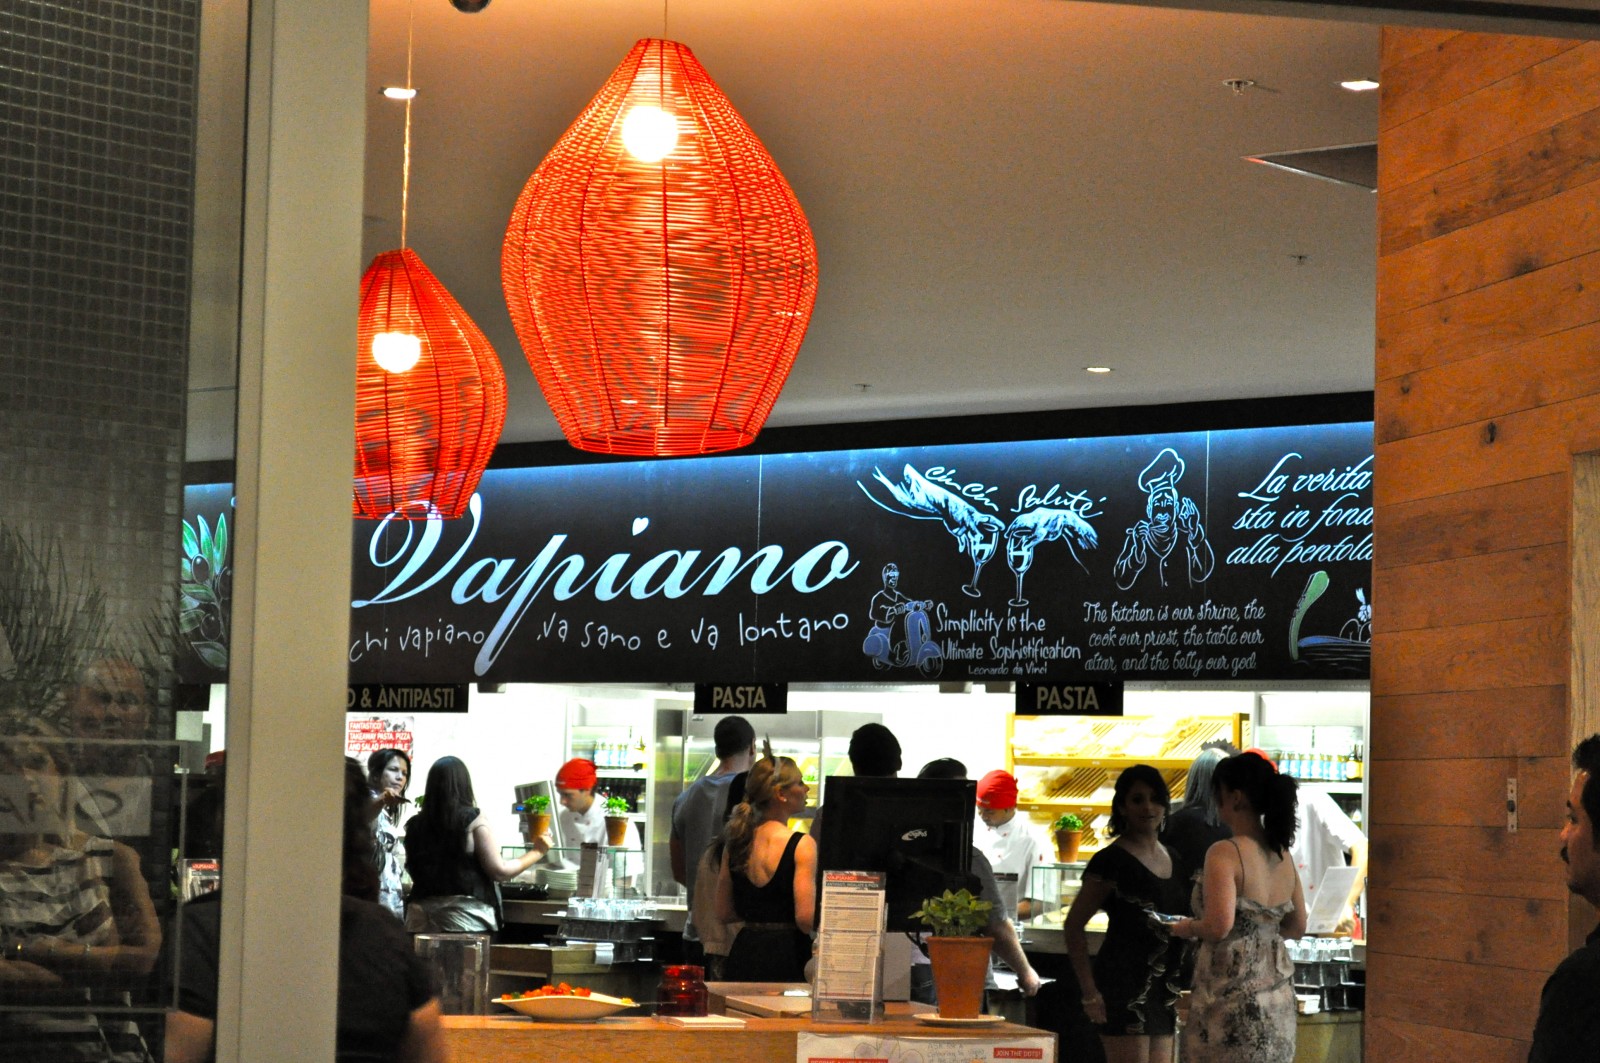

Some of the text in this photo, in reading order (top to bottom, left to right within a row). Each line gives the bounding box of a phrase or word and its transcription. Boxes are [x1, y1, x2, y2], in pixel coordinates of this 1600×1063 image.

[1238, 453, 1302, 502] La
[1232, 503, 1276, 529] sta
[1280, 504, 1310, 528] in
[1226, 534, 1280, 565] alla
[351, 492, 860, 677] Vapiano
[936, 602, 1046, 639] Simplicity is the
[1083, 601, 1107, 623] The
[1111, 601, 1154, 622] kitchen
[1157, 604, 1169, 621] is
[1172, 606, 1195, 621] our
[1244, 598, 1266, 620] the
[349, 627, 389, 662] chi
[400, 618, 486, 657] vapiano
[581, 621, 641, 651] sano
[657, 629, 671, 648] e
[691, 617, 719, 650] va
[739, 612, 849, 647] lontano
[941, 637, 984, 660] Ultimate
[1089, 626, 1116, 647] cook
[1119, 631, 1141, 647] our
[1184, 625, 1204, 646] the
[1206, 625, 1238, 645] table
[1240, 629, 1264, 645] our
[968, 661, 1048, 675] Leonardo da Vinci
[1122, 652, 1149, 670] and
[1150, 651, 1170, 671] the
[1173, 650, 1203, 677] belly
[1205, 655, 1229, 670] our
[360, 688, 372, 708] &
[377, 688, 455, 708] ANTIPASTI
[712, 685, 767, 709] PASTA
[1036, 686, 1100, 711] PASTA
[395, 732, 411, 740] PIZZA
